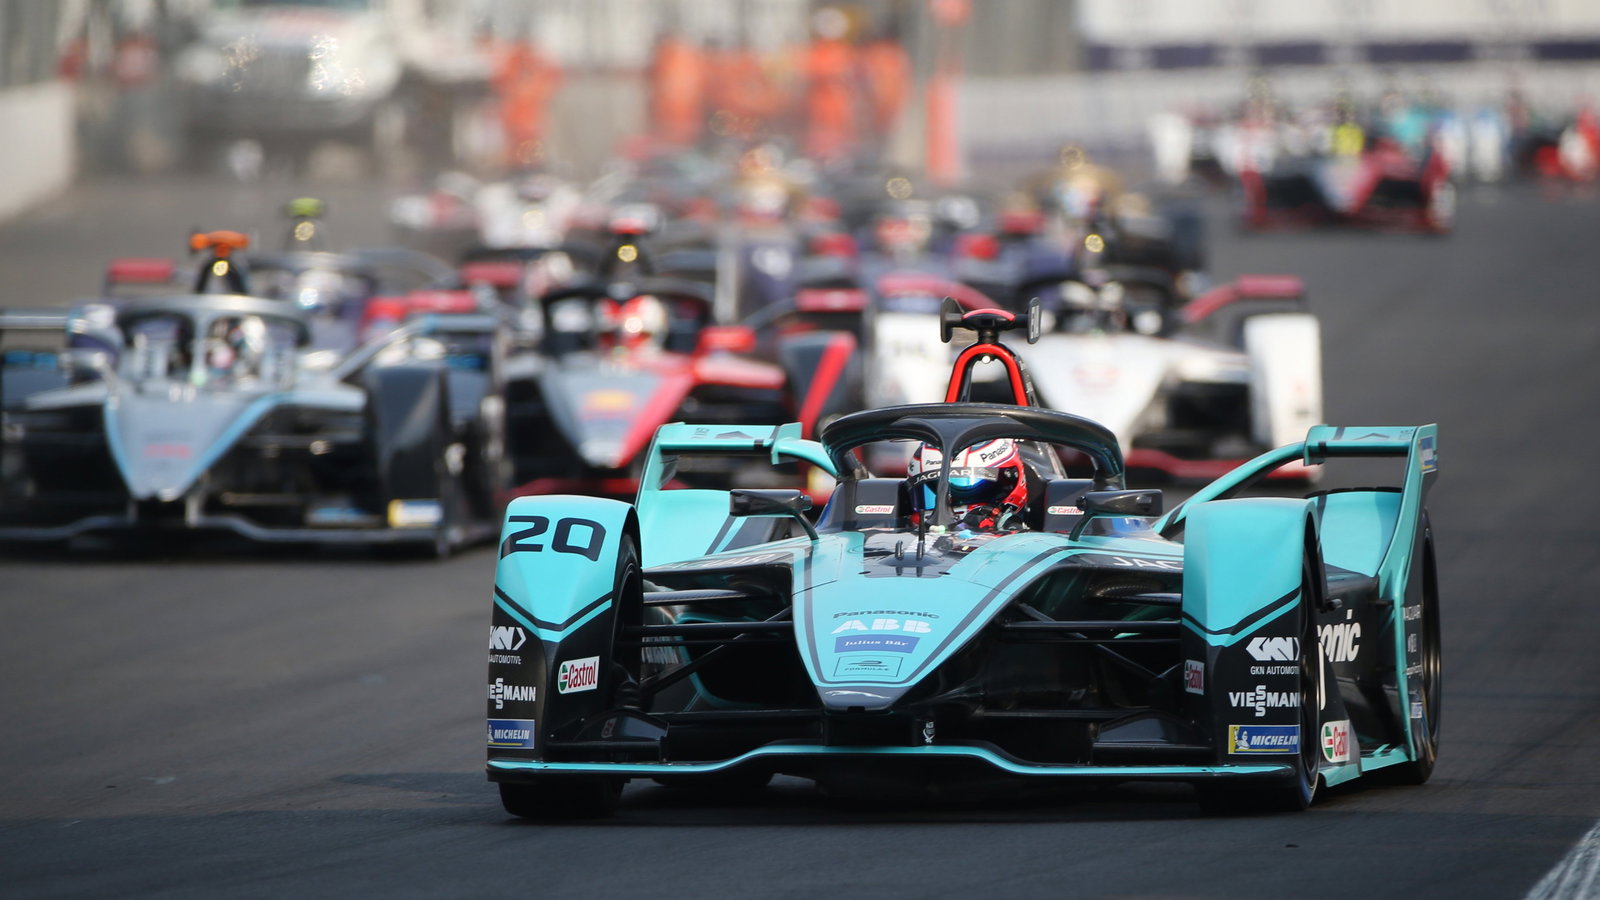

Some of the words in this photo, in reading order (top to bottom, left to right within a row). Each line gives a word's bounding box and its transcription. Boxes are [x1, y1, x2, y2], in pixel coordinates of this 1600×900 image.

[501, 515, 607, 562] 20
[833, 610, 940, 619] Panasonic
[831, 618, 932, 634] ABB
[568, 661, 598, 688] Castrol
[1250, 666, 1265, 675] GKN
[494, 729, 530, 740] MICHELIN
[1250, 735, 1299, 746] MICHELIN
